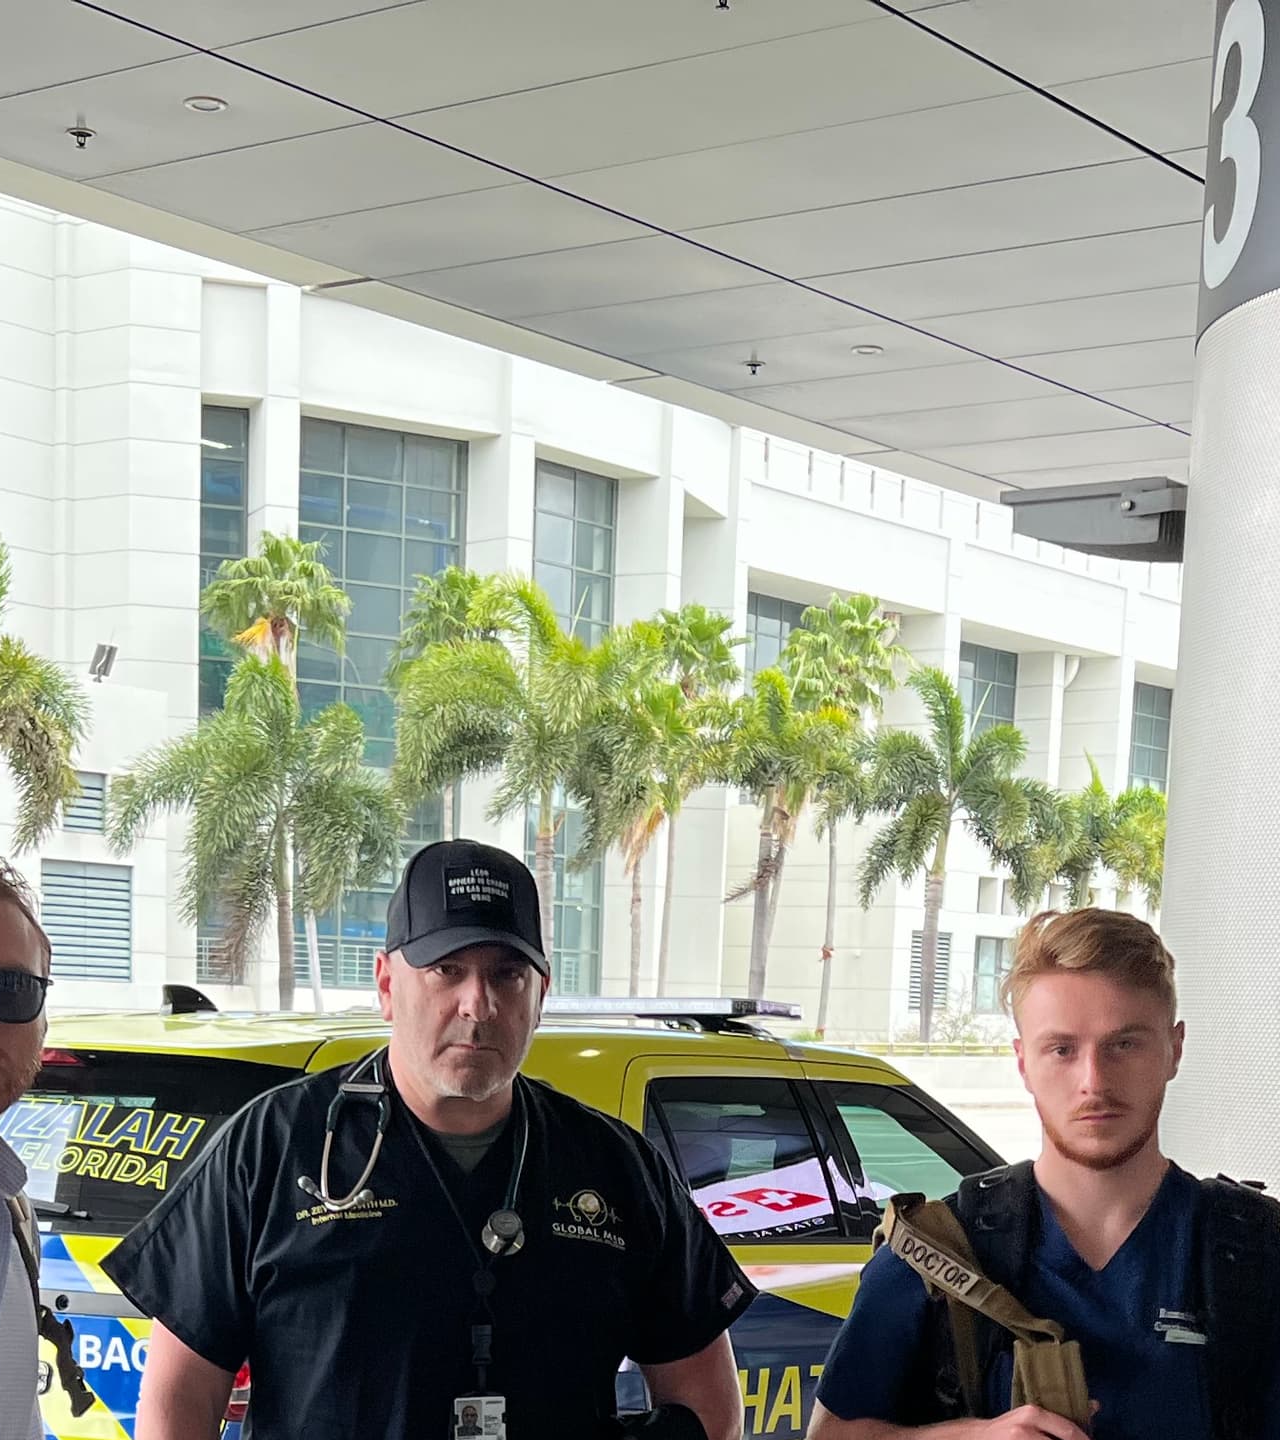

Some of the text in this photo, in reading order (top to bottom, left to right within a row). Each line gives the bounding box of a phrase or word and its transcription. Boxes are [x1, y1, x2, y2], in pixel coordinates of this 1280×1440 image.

[19, 1141, 169, 1191] FLORIDA
[551, 1222, 601, 1239] GLOBAL
[901, 1237, 971, 1290] DOCTOR
